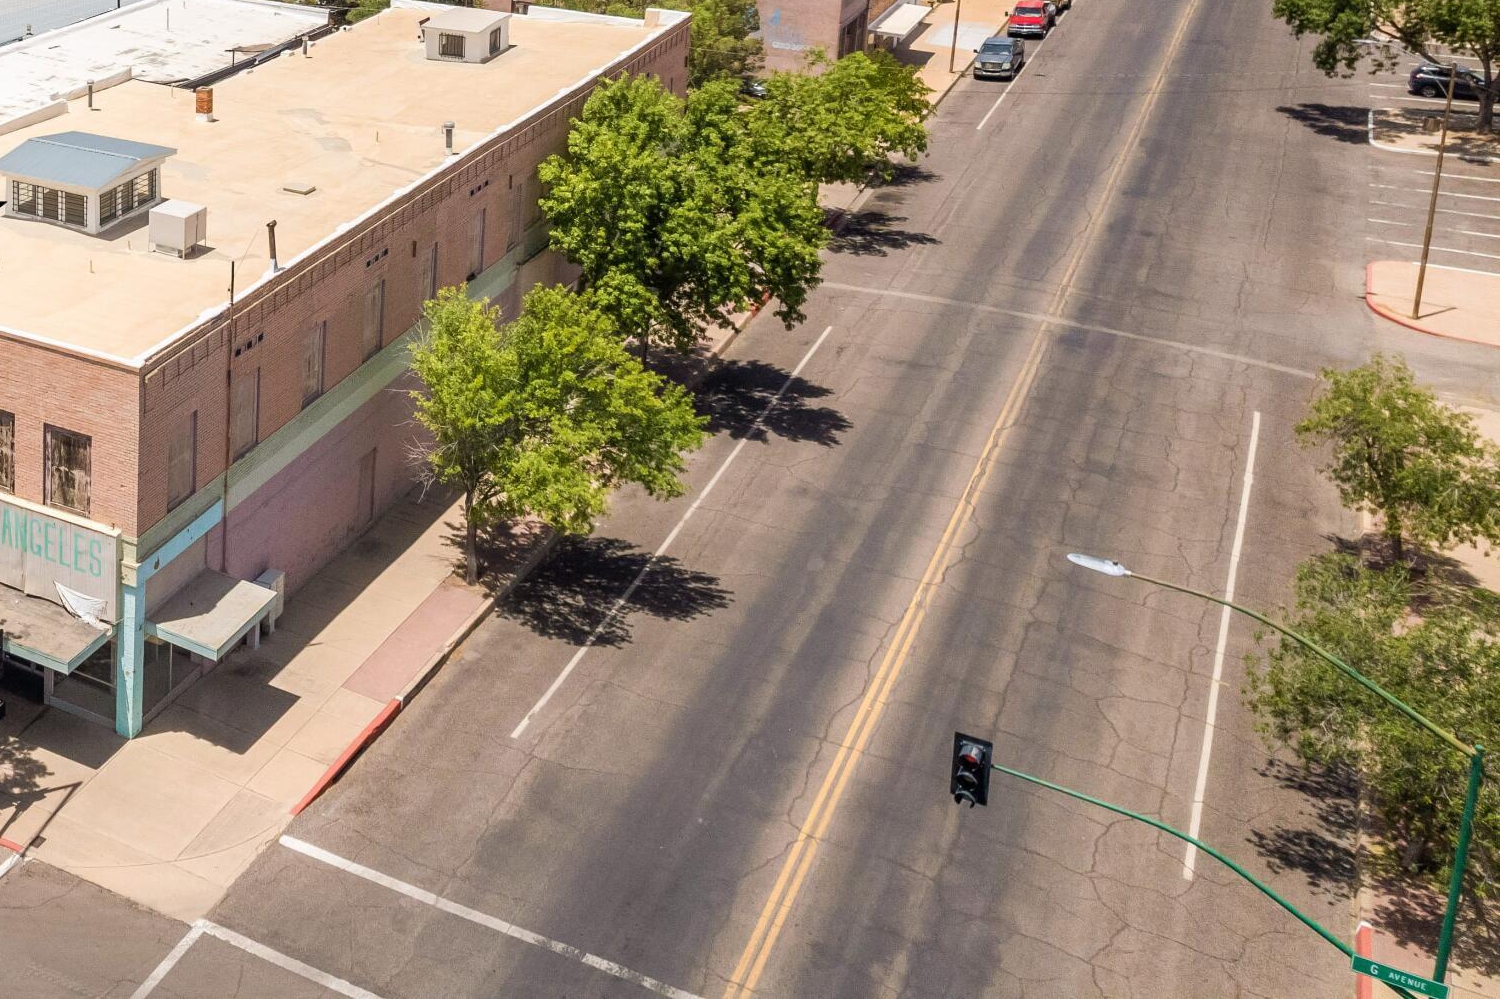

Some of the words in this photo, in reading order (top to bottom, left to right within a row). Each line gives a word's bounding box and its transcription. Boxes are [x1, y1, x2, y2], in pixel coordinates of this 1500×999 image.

[1, 506, 102, 578] ANGELES
[1370, 964, 1379, 976] G
[1388, 972, 1427, 991] AVENUE
